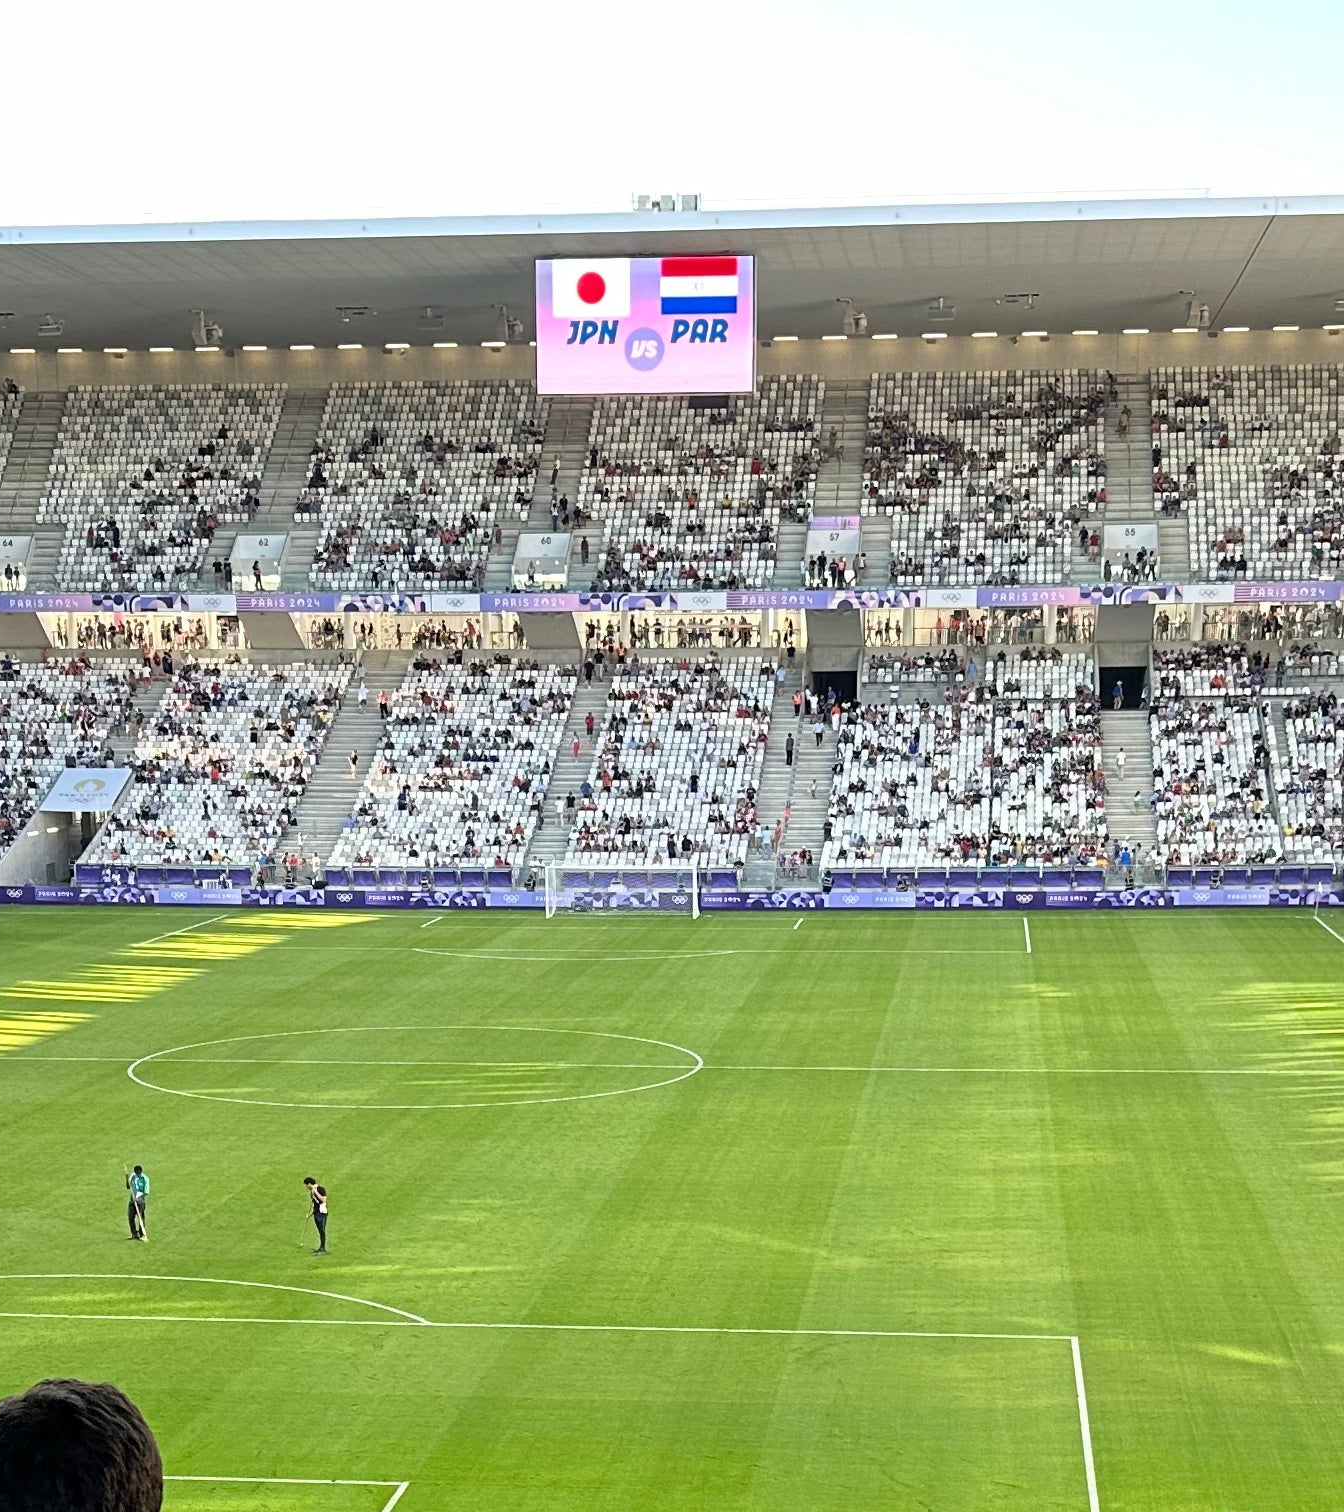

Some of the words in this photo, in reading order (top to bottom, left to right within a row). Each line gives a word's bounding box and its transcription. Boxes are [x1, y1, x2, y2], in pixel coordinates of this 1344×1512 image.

[567, 320, 619, 345] JPN
[630, 340, 658, 359] VS
[670, 318, 729, 344] PAR
[1, 538, 14, 548] 64
[257, 537, 270, 547] 62
[991, 592, 1028, 603] PARIS
[1031, 591, 1064, 603] 2024
[1250, 587, 1288, 598] PARIS
[1291, 588, 1325, 598] 2024
[9, 598, 45, 609] PARIS
[47, 599, 79, 609] 2024
[250, 597, 287, 608] PARIS
[289, 598, 320, 608] 2024
[494, 597, 531, 608] PARIS
[533, 598, 566, 608] 2024
[741, 594, 777, 606] PARIS
[780, 594, 814, 606] 2024
